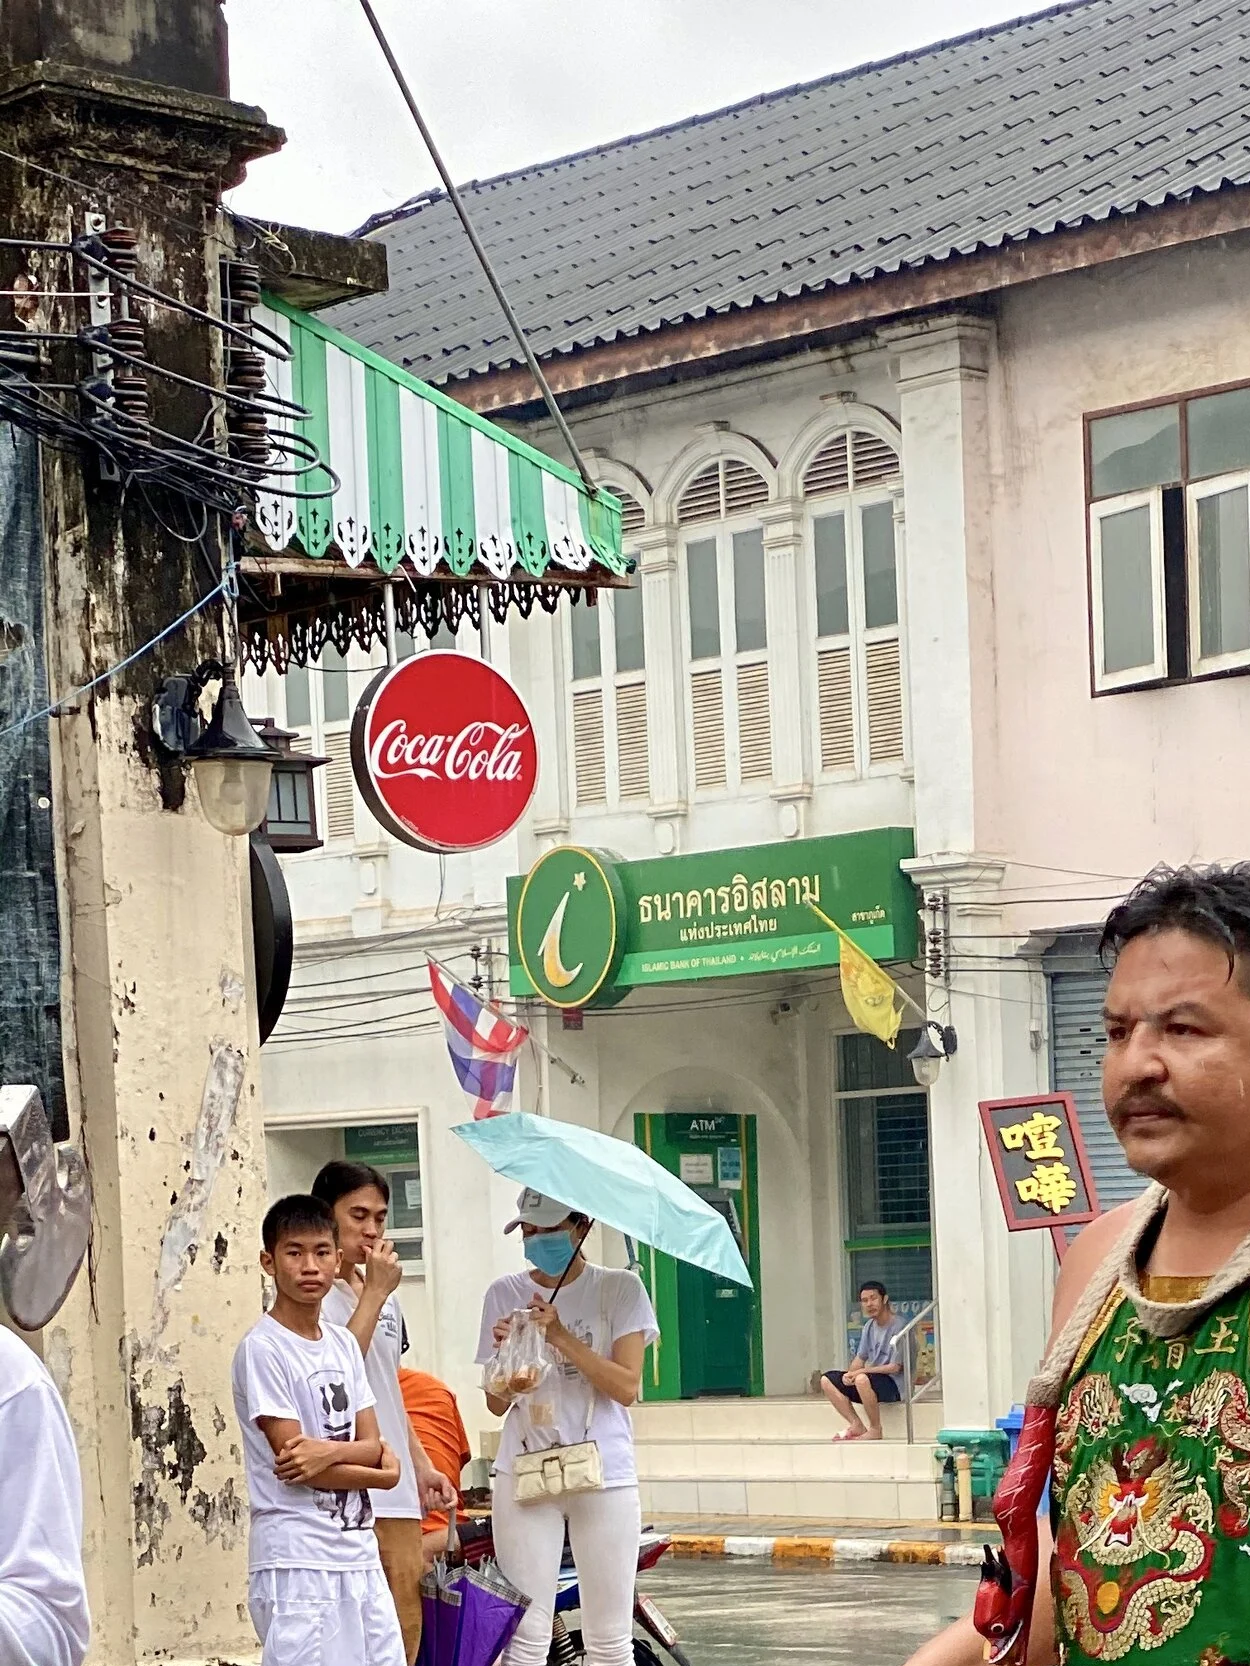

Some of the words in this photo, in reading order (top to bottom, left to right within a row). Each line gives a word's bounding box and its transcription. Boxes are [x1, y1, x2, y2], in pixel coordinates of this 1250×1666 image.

[371, 719, 529, 782] Coca-Cola
[638, 873, 821, 923] ธนาคารอิสลาม
[679, 914, 778, 943] แห่งประเทศไทย
[642, 960, 669, 973] ISLAMIC
[670, 958, 690, 971] BANK
[690, 957, 701, 968] OF
[702, 954, 737, 966] THAILAND
[690, 1119, 716, 1132] ATM
